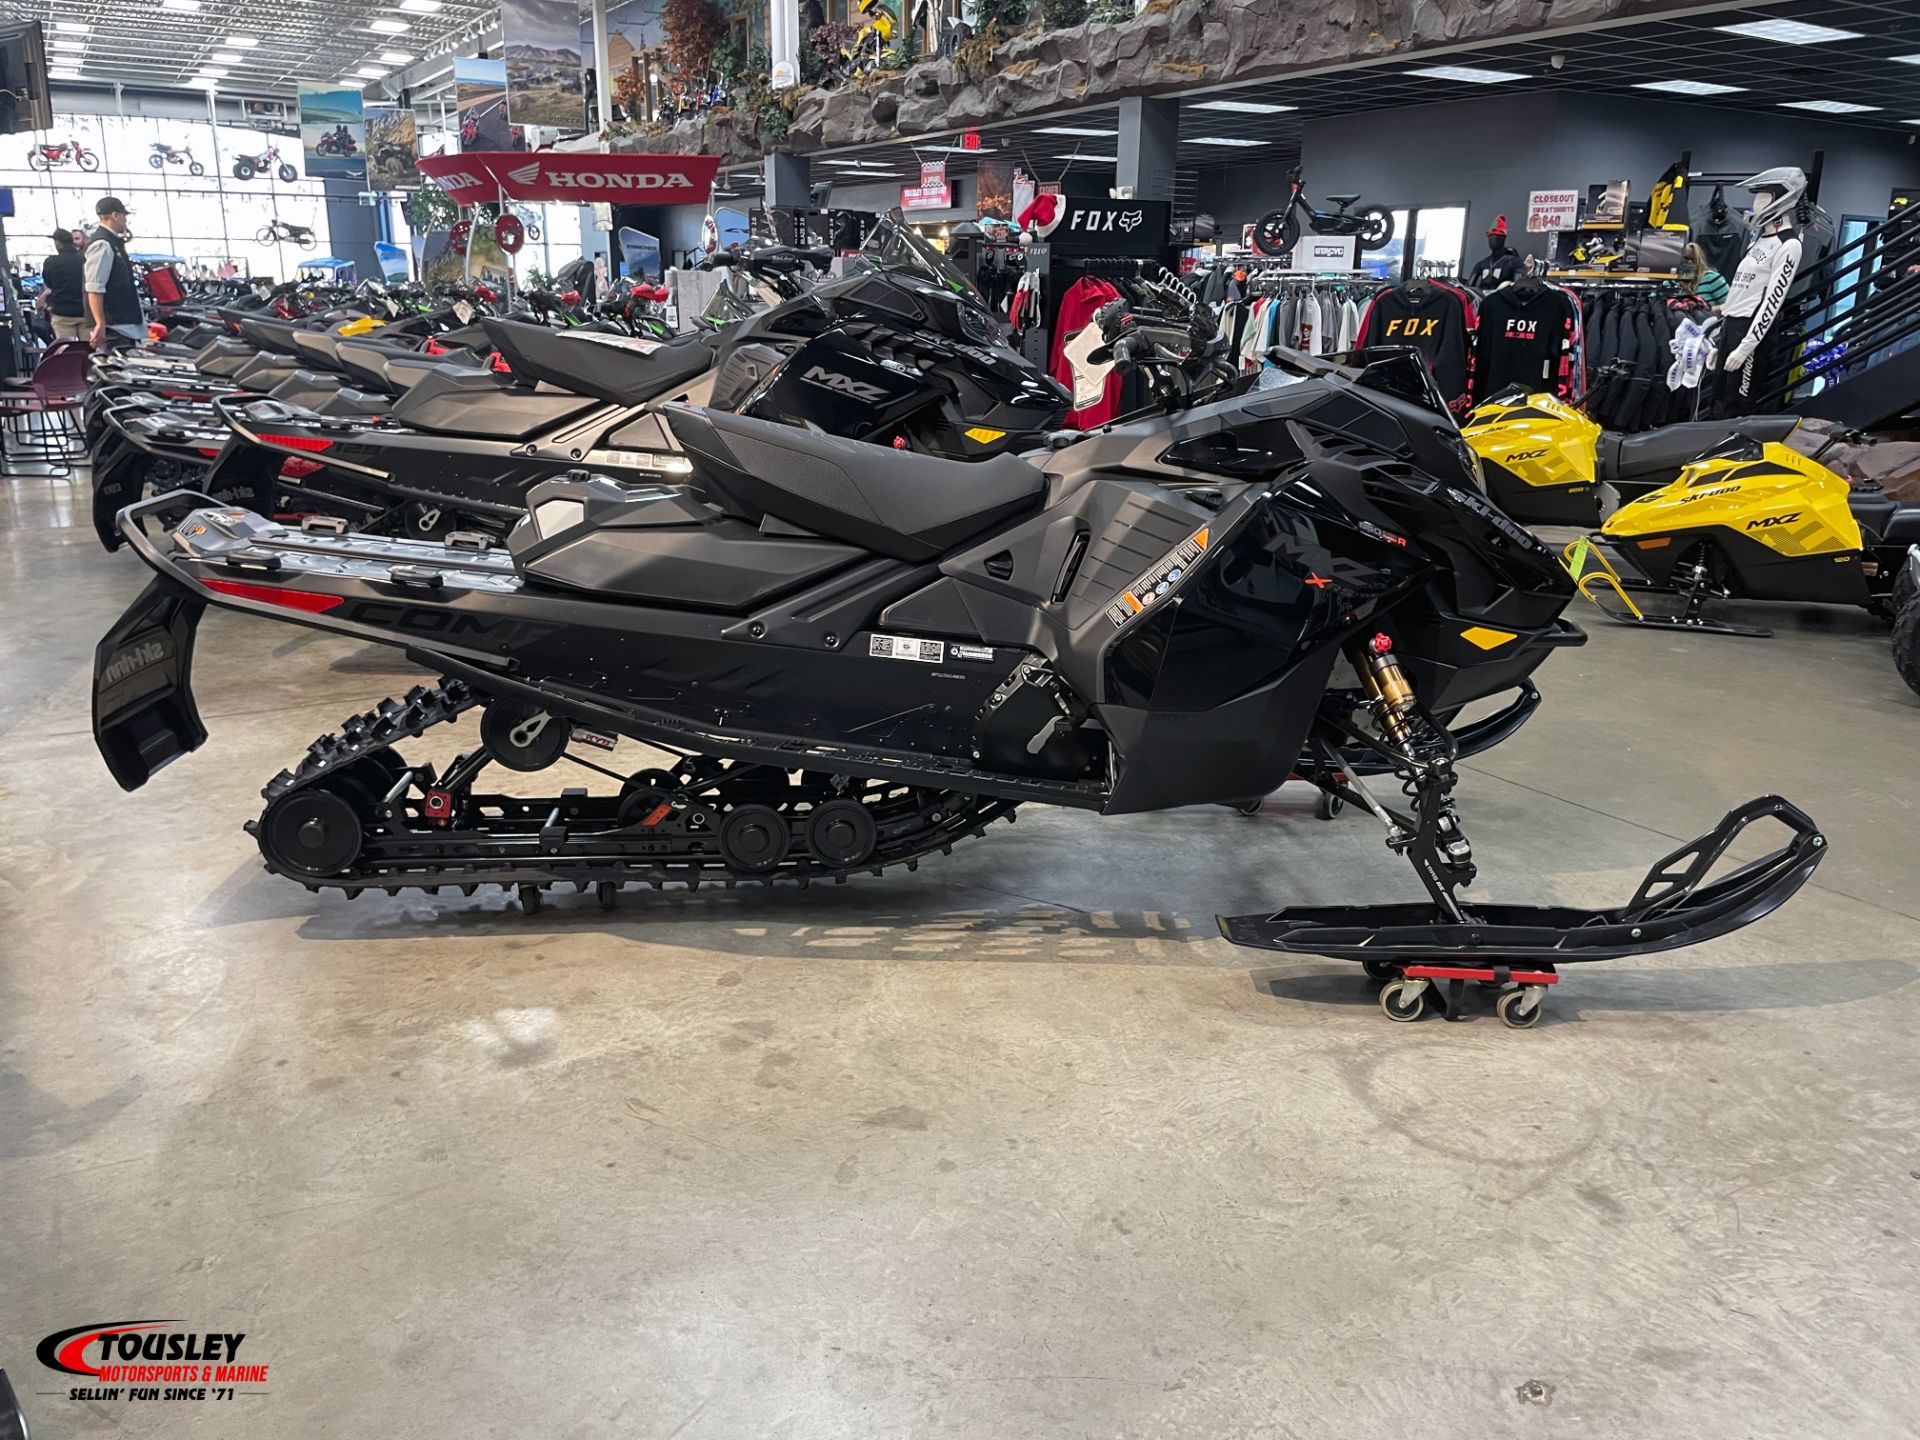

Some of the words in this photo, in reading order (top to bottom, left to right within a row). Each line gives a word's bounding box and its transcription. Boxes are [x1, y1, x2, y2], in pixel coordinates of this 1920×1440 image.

[434, 172, 483, 189] NDA
[545, 171, 694, 188] HONDA
[1533, 194, 1575, 203] CLOSEOUT
[1070, 210, 1117, 231] FOX
[1542, 214, 1561, 227] $40
[1753, 255, 1796, 342] FASTHOUSE
[1386, 318, 1439, 337] FOX
[1507, 319, 1537, 332] FOX
[803, 365, 890, 401] MXZ
[1739, 351, 1754, 397] FASTHOU
[1505, 448, 1550, 462] MXZ
[1447, 488, 1532, 549] ski-doo
[1746, 512, 1804, 531] MXZ
